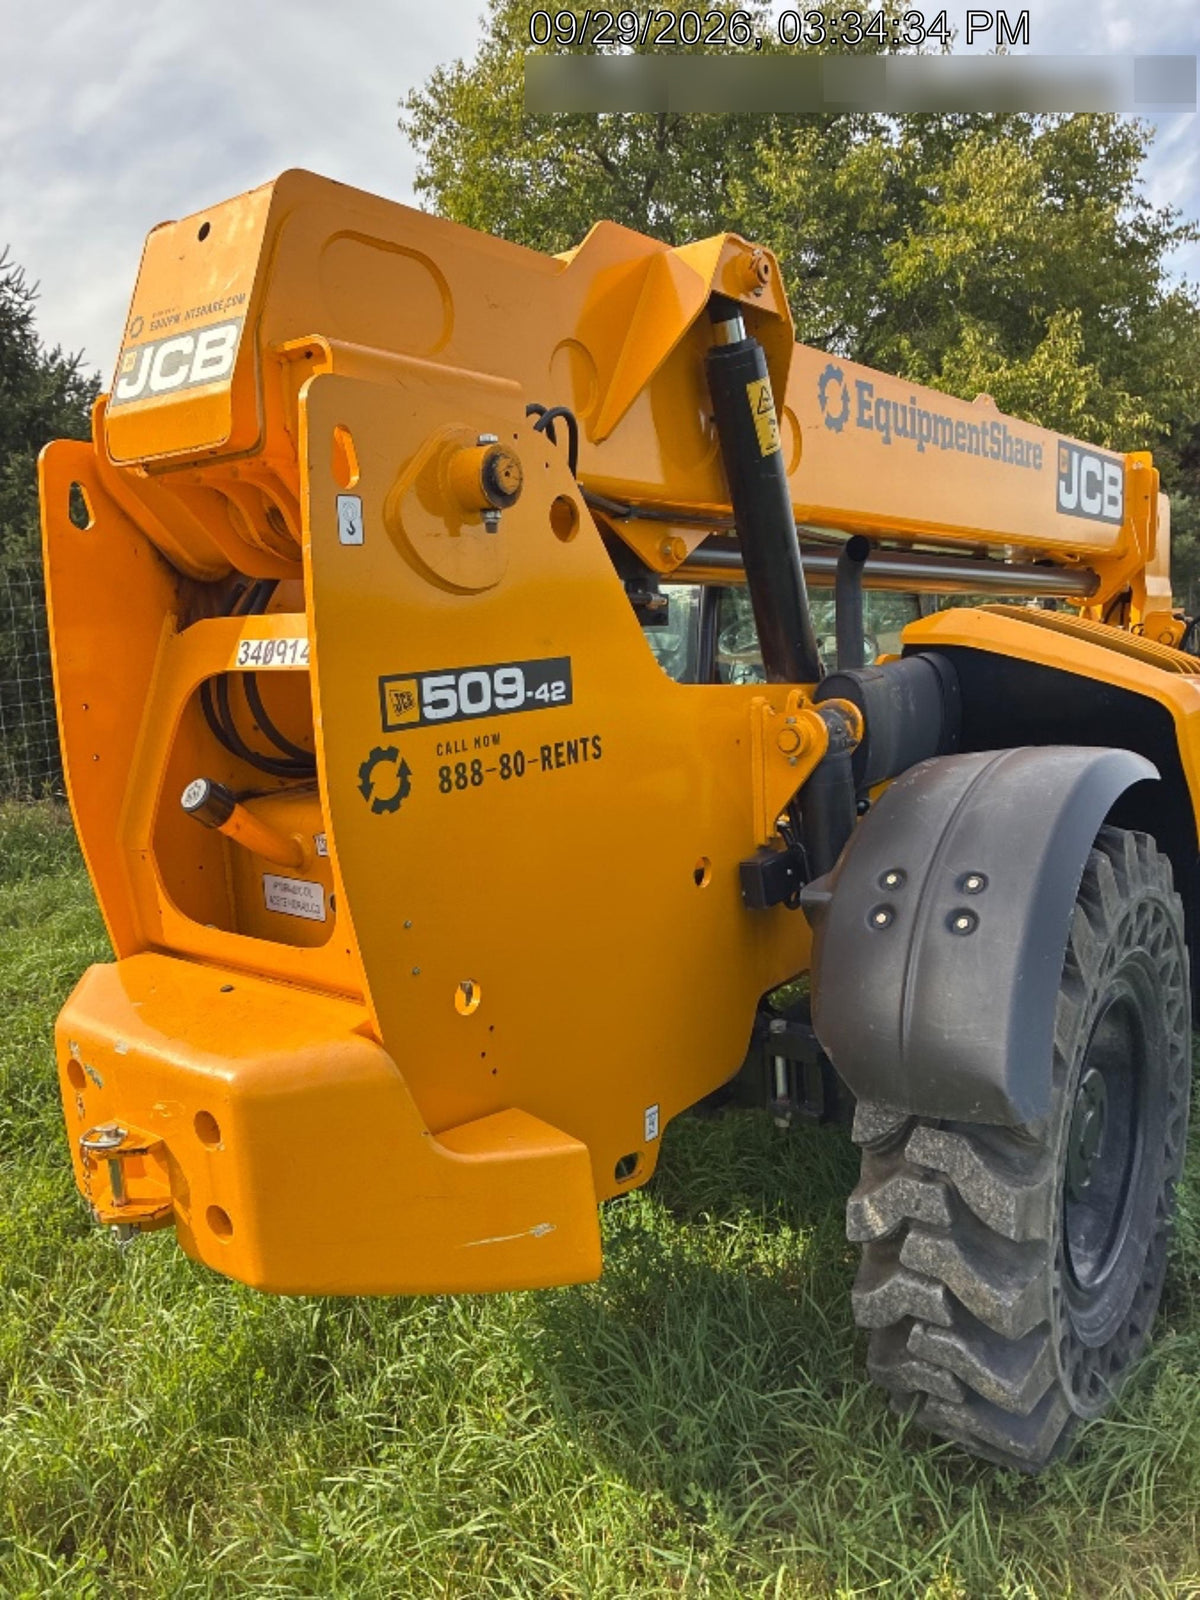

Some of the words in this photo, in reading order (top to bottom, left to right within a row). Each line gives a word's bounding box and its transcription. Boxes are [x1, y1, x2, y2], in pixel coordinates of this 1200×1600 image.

[116, 324, 239, 399] JCB
[855, 379, 1043, 471] EquipmentShare
[1058, 450, 1123, 520] JCB
[421, 667, 567, 720] 509-42
[436, 742, 469, 757] CALL
[473, 732, 501, 750] NOW
[438, 735, 603, 794] 888-80-RENTS
